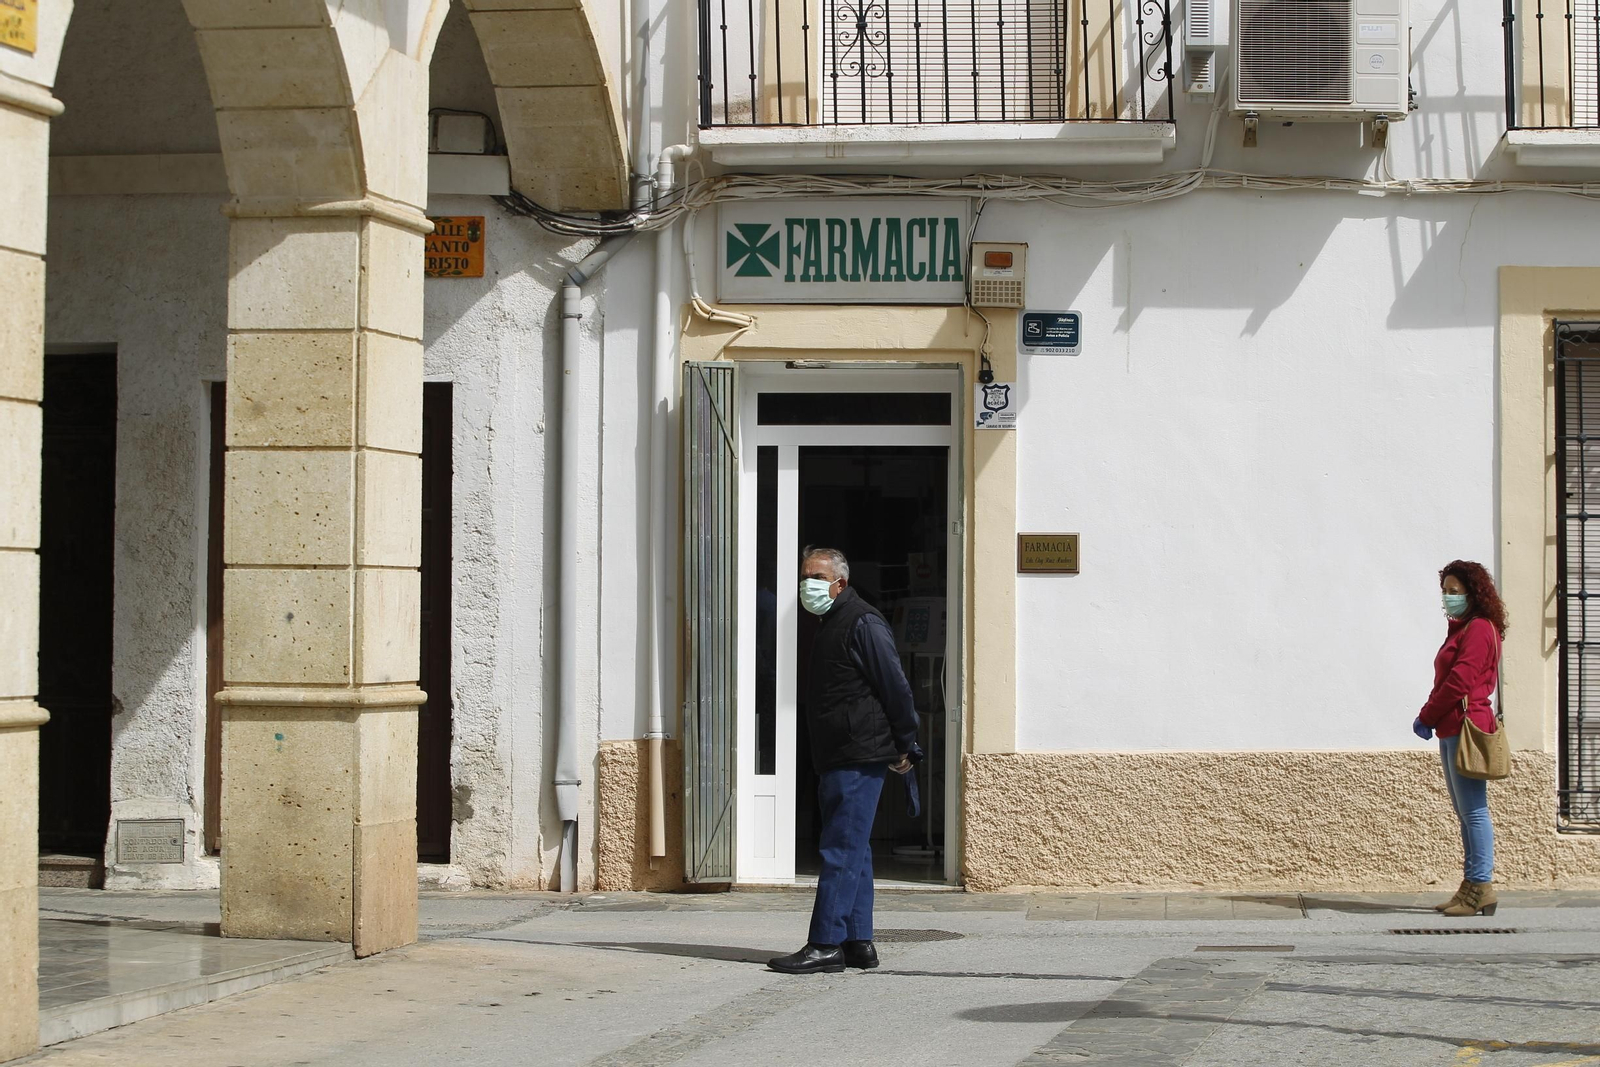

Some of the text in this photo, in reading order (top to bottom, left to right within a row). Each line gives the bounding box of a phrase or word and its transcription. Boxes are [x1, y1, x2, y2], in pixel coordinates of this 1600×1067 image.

[425, 225, 464, 236] ALLE
[784, 217, 964, 283] FARMACIA
[425, 256, 469, 270] RISTO
[1025, 542, 1073, 552] FARMACIA
[123, 838, 169, 846] CONTADOR
